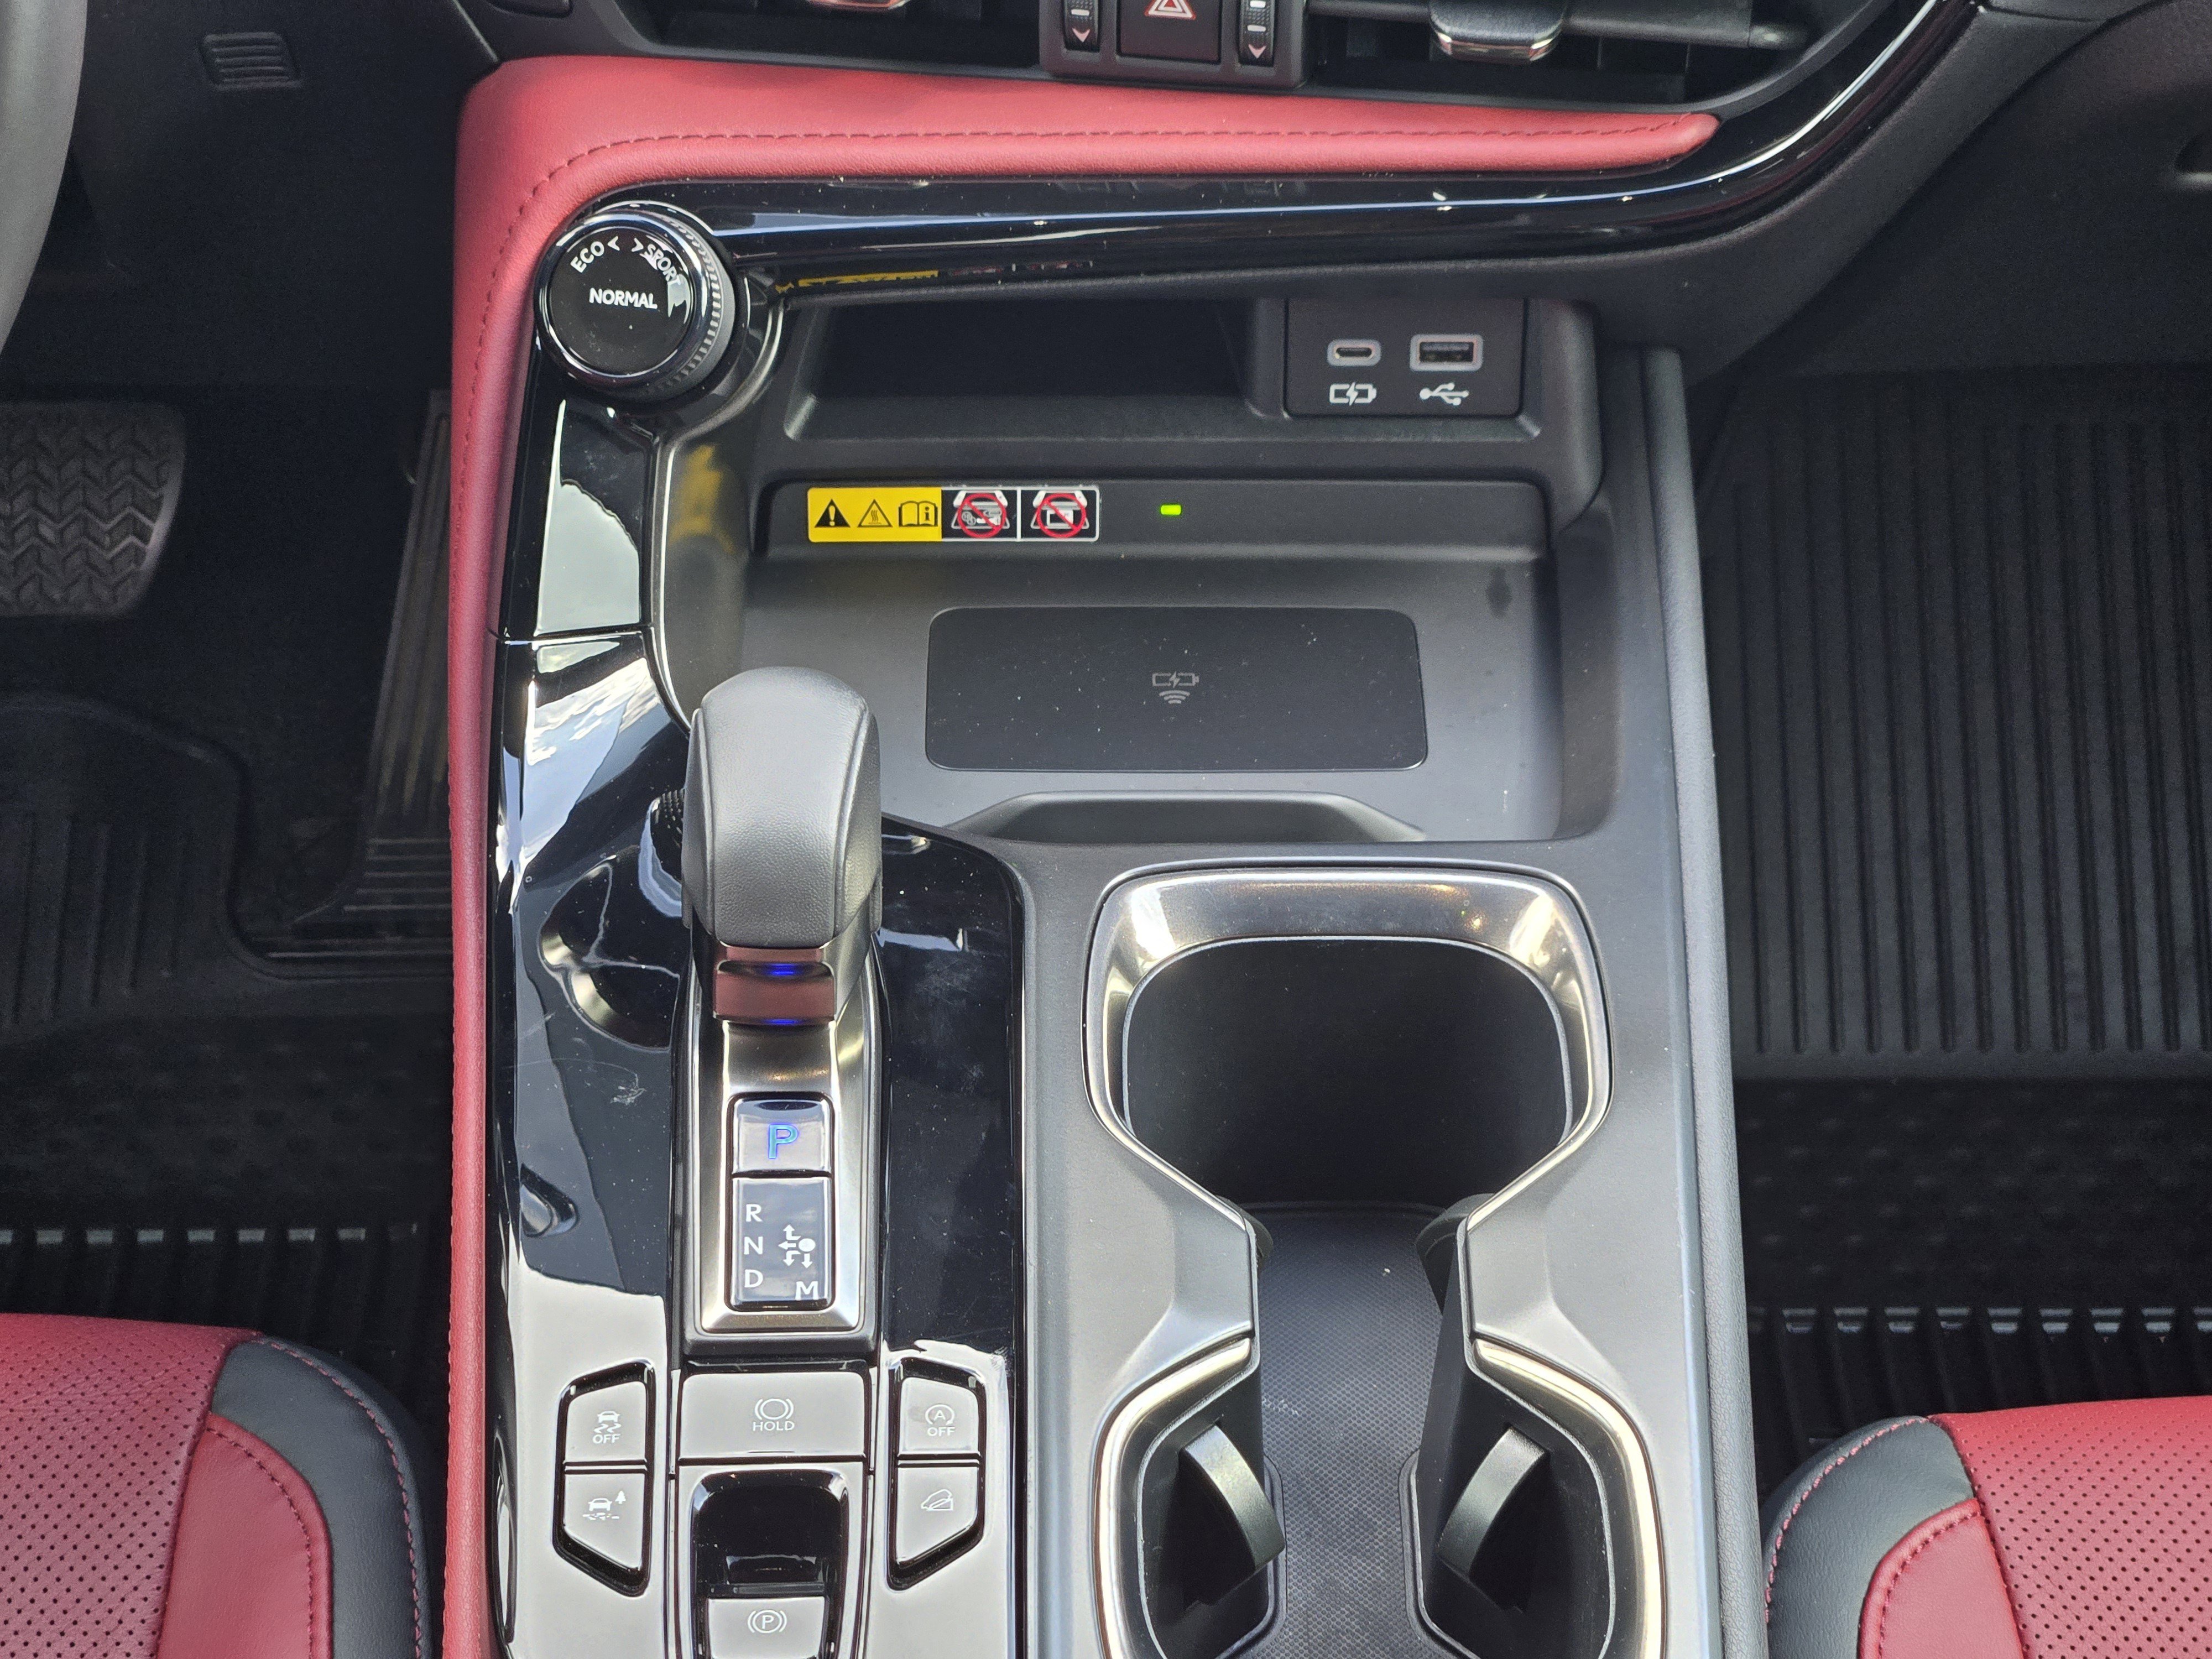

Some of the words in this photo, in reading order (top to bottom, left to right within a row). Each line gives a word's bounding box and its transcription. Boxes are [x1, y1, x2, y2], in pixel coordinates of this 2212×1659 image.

[570, 241, 605, 273] ECO
[644, 243, 681, 286] SPORT
[588, 287, 658, 310] NORMAL
[768, 1123, 799, 1160] P
[745, 1203, 763, 1223] R
[743, 1236, 764, 1255] N
[744, 1269, 764, 1288] D
[795, 1281, 820, 1301] M
[933, 1410, 946, 1421] A
[752, 1421, 795, 1431] HOLD
[927, 1427, 956, 1436] OFF
[592, 1433, 621, 1444] OFF
[761, 1615, 774, 1629] P
